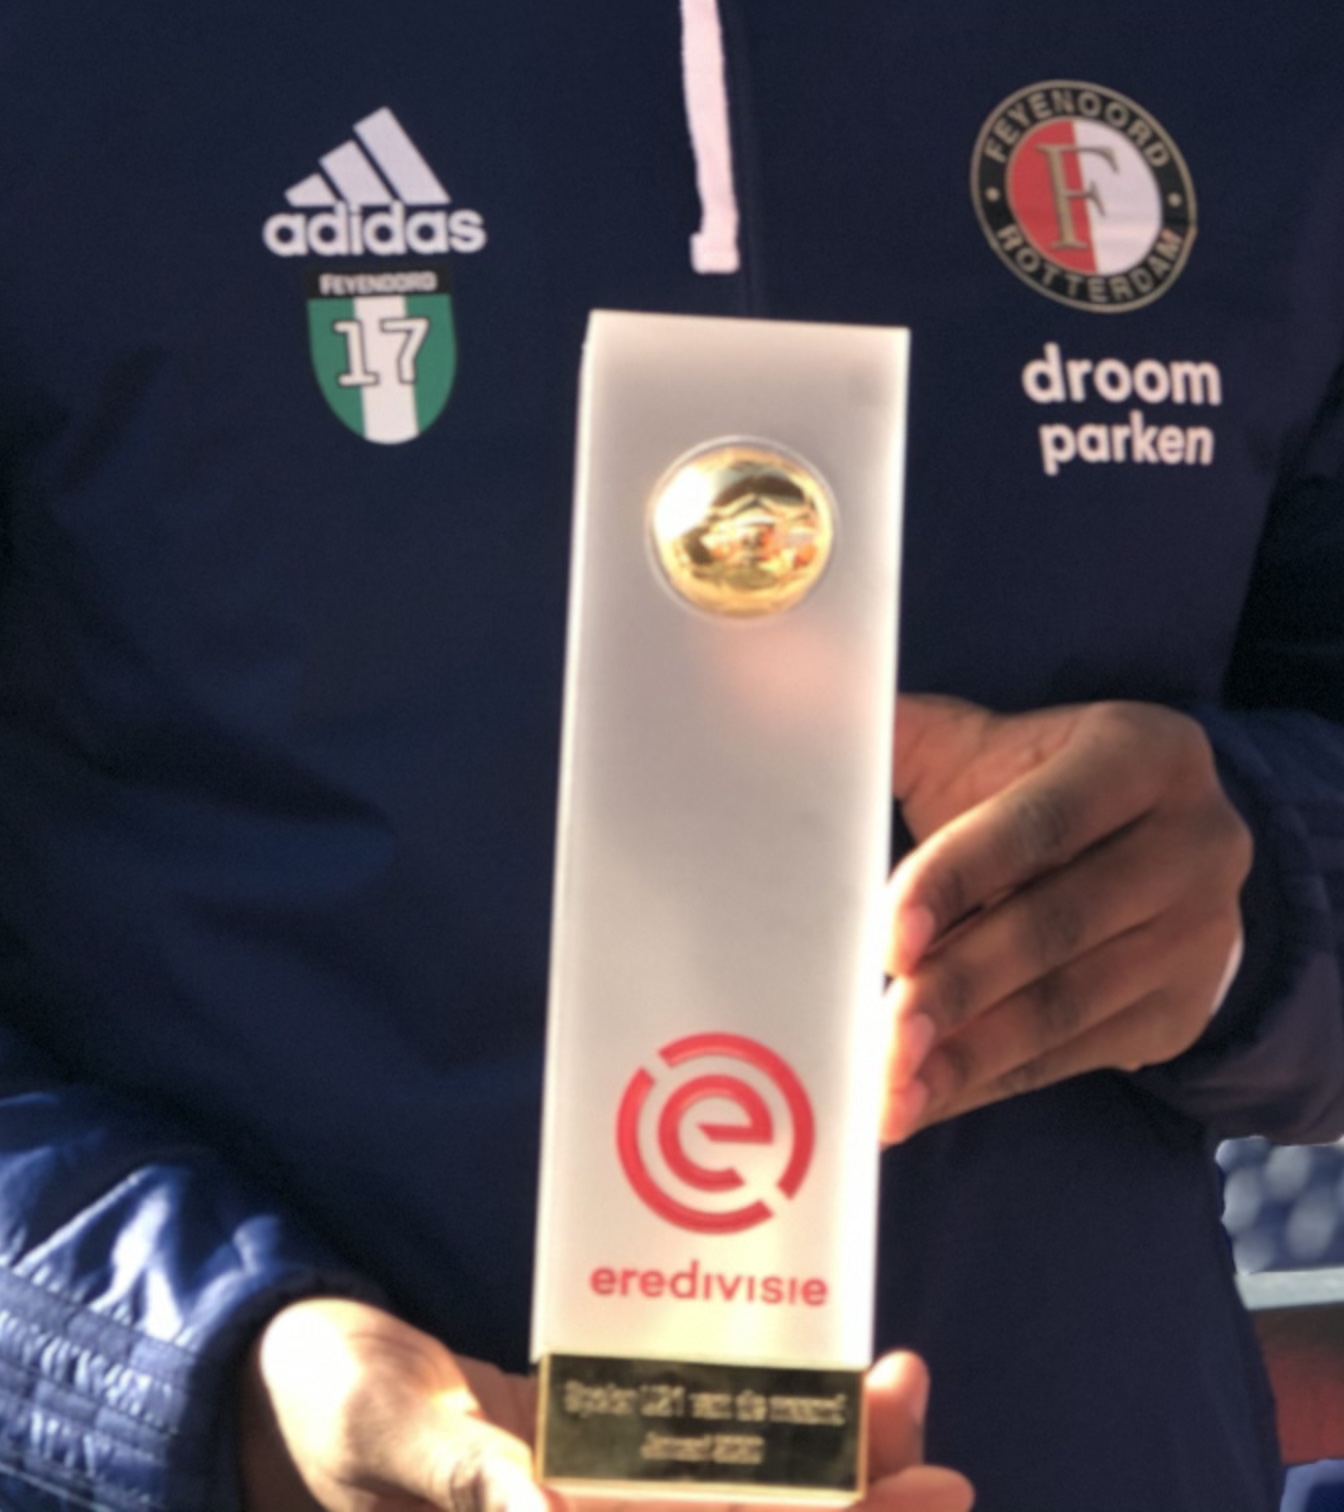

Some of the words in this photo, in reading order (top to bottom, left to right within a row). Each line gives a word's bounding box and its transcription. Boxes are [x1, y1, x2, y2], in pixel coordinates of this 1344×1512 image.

[984, 88, 1171, 169] FEYENOORD
[262, 199, 487, 257] adidas
[996, 223, 1184, 303] ROTTERDAM
[333, 317, 431, 387] 17
[1021, 342, 1222, 407] droom
[1037, 408, 1215, 477] parken
[589, 1258, 829, 1308] eredivisie
